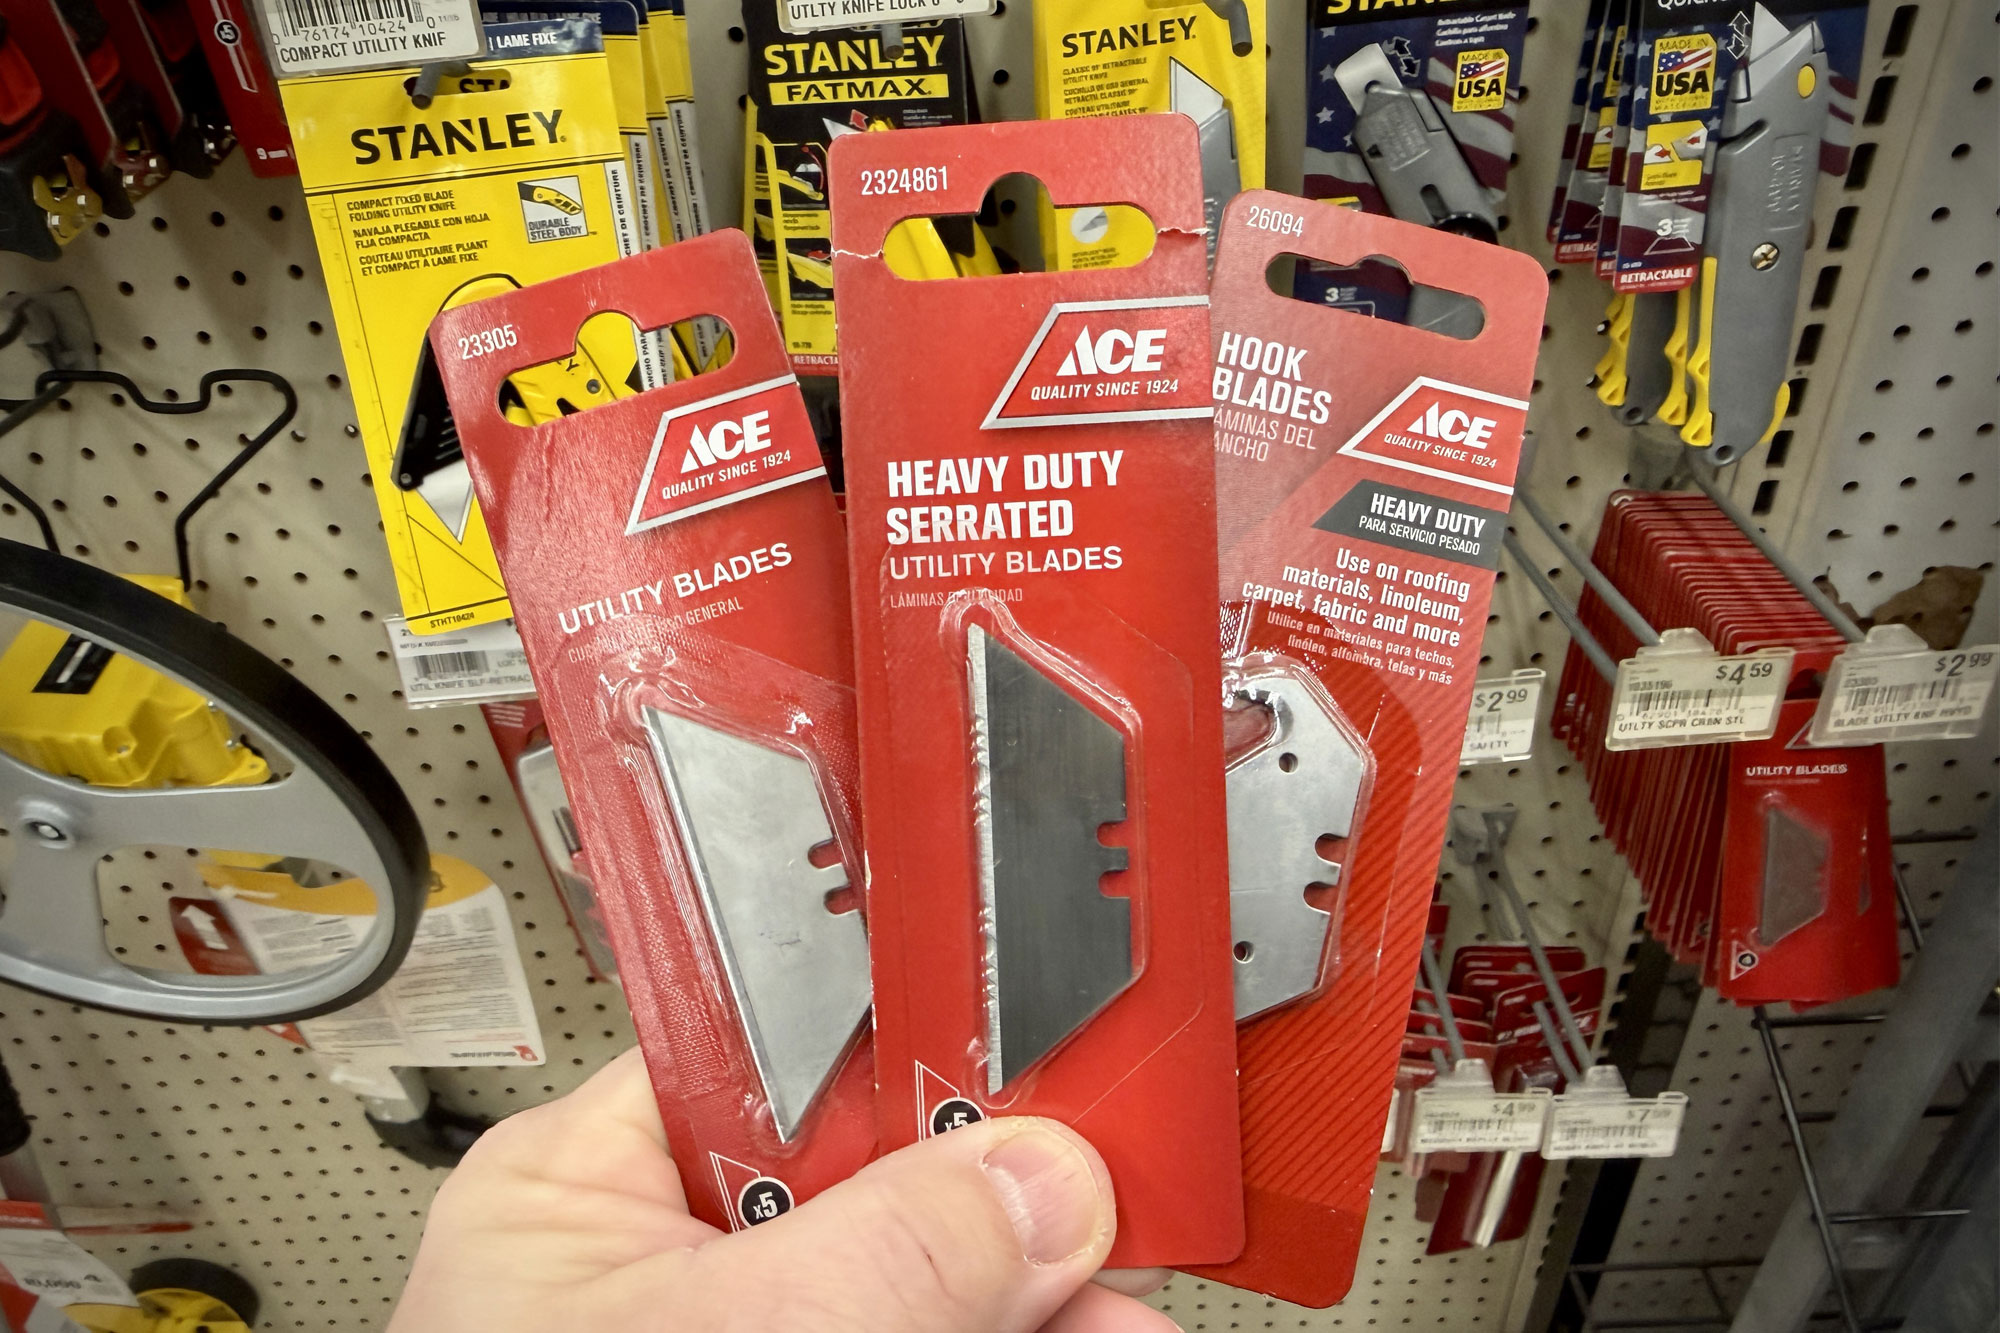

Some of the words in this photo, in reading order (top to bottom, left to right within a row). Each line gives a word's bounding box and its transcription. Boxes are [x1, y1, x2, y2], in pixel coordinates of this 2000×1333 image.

[791, 1, 836, 20] UTLTY
[842, 0, 885, 15] KNIFE
[302, 26, 350, 42] 76174
[359, 20, 406, 36] 10424
[427, 16, 436, 29] 0
[496, 33, 531, 49] LAME
[532, 32, 558, 46] FIXE
[1062, 15, 1198, 58] STANLEY
[280, 42, 348, 63] COMPACT
[353, 36, 407, 55] UTILITY
[412, 31, 447, 48] KNIF
[763, 34, 945, 76] STANLEY
[786, 77, 929, 102] FATMAX
[1458, 78, 1502, 98] USA
[1655, 70, 1710, 97] USA
[350, 109, 563, 165] STANLEY
[860, 165, 949, 196] 2324861
[346, 196, 393, 212] COMPACT
[394, 193, 422, 206] FIXED
[423, 189, 454, 203] BLADE
[349, 208, 391, 222] FOLDING
[392, 204, 427, 217] UTILITY
[428, 200, 456, 213] KNIFE
[352, 225, 393, 238] NAVAJA
[393, 218, 441, 233] PLEGABLE
[442, 216, 463, 227] CON
[464, 213, 490, 225] HOJA
[528, 217, 570, 231] DURABLE
[530, 229, 557, 241] STEEL
[558, 225, 582, 237] BODY
[1246, 205, 1304, 237] 26094
[1657, 218, 1674, 236] 3
[378, 231, 431, 246] COMPACTA
[359, 251, 403, 266] COUTEAU
[405, 244, 453, 259] UTILITAIRE
[361, 266, 373, 276] ET
[375, 259, 421, 274] COMPACT
[431, 254, 457, 267] LAME
[459, 252, 479, 263] FIXE
[1620, 266, 1693, 284] RETRACTABLE
[1325, 287, 1339, 302] 3
[458, 322, 518, 361] 23305
[1056, 325, 1168, 376] ACE
[1217, 330, 1309, 382] HOOK
[1030, 383, 1092, 401] QUALITY
[1095, 380, 1141, 397] SINCE
[1145, 378, 1179, 394] 1924
[1212, 366, 1332, 425] BLADES
[680, 410, 772, 474] ACE
[1213, 406, 1280, 444] ÁMINAS
[1284, 424, 1318, 450] DEL
[1406, 401, 1497, 451] ACE
[1383, 432, 1432, 452] QUALITY
[1432, 444, 1468, 463] SINCE
[1470, 452, 1498, 469] 1924
[661, 471, 715, 500] QUALITY
[718, 460, 758, 482] SINCE
[762, 448, 792, 470] 1924
[887, 455, 1009, 498] HEAVY
[1023, 449, 1124, 491] DUTY
[886, 499, 1074, 546] SERRATED
[1370, 492, 1433, 525] HEAVY
[1434, 508, 1486, 539] DUTY
[1359, 515, 1387, 534] PARA
[1388, 522, 1437, 546] SERVICIO
[1438, 535, 1480, 556] PESADO
[889, 551, 996, 580] UTILITY
[1006, 545, 1124, 574] BLADES
[1335, 547, 1371, 574] Use
[1375, 562, 1398, 581] on
[1404, 567, 1471, 602] roofing
[558, 580, 664, 634] UTILITY
[673, 542, 793, 598] BLADES
[1282, 565, 1374, 605] materials,
[1380, 584, 1465, 626] linoleum,
[685, 596, 744, 626] GENERAL
[1241, 581, 1307, 613] carpet,
[1311, 593, 1368, 626] fabric
[1372, 611, 1408, 635] and
[1412, 622, 1461, 647] more
[1267, 611, 1304, 631] Utilice
[1306, 623, 1321, 635] en
[1323, 625, 1383, 650] materiales
[1385, 642, 1412, 660] para
[1414, 646, 1455, 669] techos,
[1330, 646, 1384, 670] alfombra,
[1388, 659, 1416, 677] telas
[1418, 669, 1426, 681] y
[1428, 669, 1453, 685] más
[1746, 764, 1793, 777] UTILITY
[753, 1191, 778, 1220] x5
